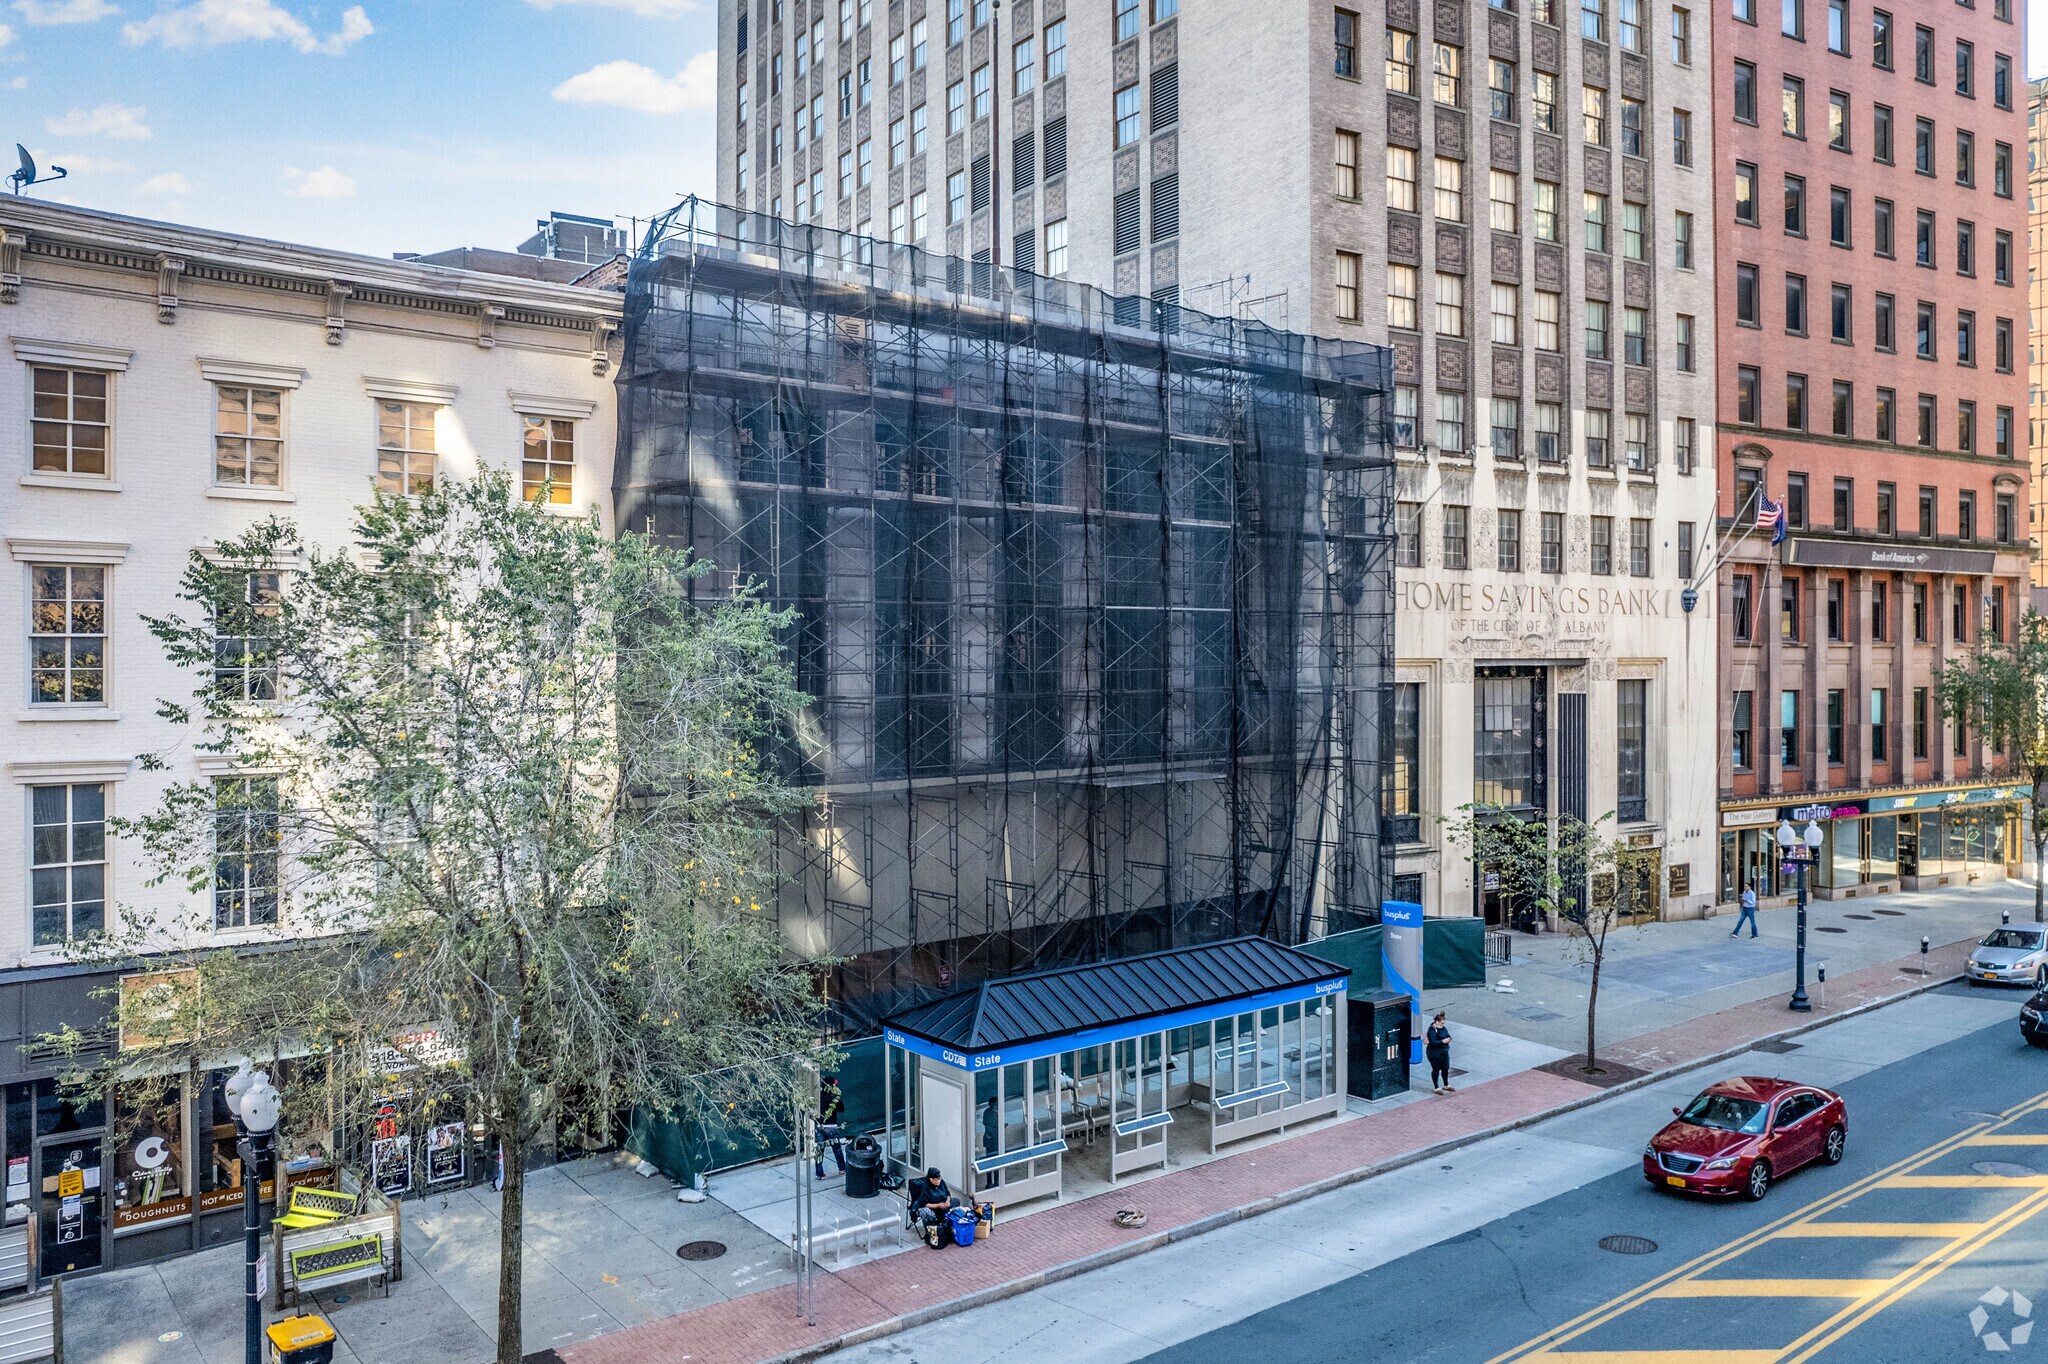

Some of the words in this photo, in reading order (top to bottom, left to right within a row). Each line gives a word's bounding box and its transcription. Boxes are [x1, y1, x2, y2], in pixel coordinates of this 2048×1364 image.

[1871, 551, 1886, 561] Bank
[1892, 552, 1915, 563] America
[1394, 581, 1472, 612] HOME
[1482, 584, 1590, 614] SAVINGS
[1597, 588, 1659, 616] BANK
[1451, 619, 1467, 632] OF
[1471, 619, 1489, 632] THE
[1526, 620, 1541, 633] OF
[1564, 621, 1608, 633] ALBANY
[1740, 812, 1752, 820] Hair
[1753, 811, 1772, 820] Gallery
[1797, 803, 1831, 819] metro
[1384, 908, 1411, 921] busplus
[1315, 979, 1343, 994] busplus
[887, 1030, 905, 1045] State
[974, 1055, 1001, 1067] State
[202, 1196, 218, 1206] HOT
[226, 1191, 243, 1202] ICED
[125, 1203, 186, 1221] DOUGHNUTS
